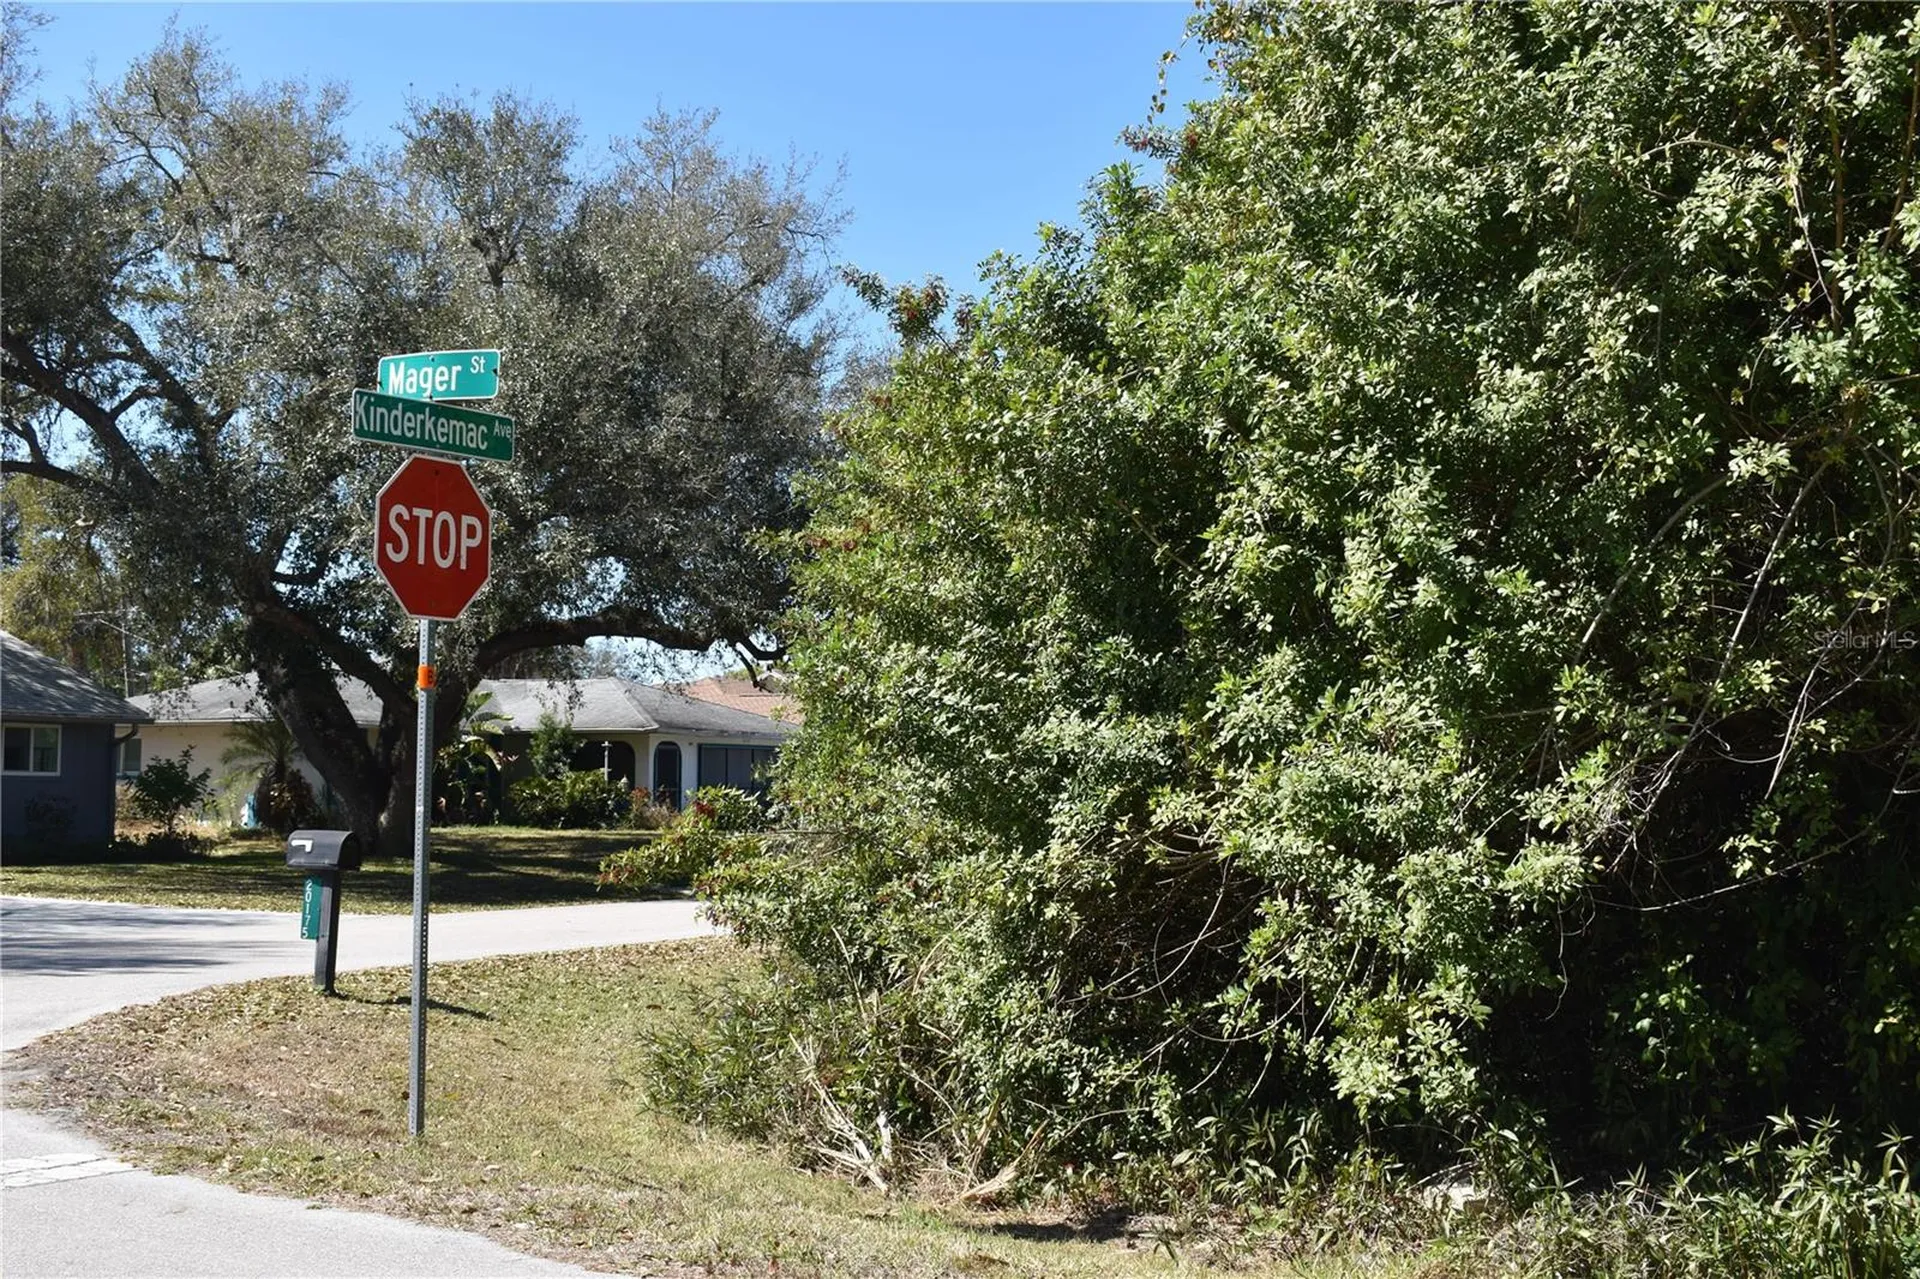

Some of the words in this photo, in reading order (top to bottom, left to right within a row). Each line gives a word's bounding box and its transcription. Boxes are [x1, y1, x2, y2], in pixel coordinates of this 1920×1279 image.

[388, 362, 462, 397] Mager
[470, 355, 486, 373] St
[355, 394, 489, 450] Kinderkemac
[493, 419, 512, 440] Ave
[385, 503, 483, 570] STOP
[302, 880, 312, 939] 20175
